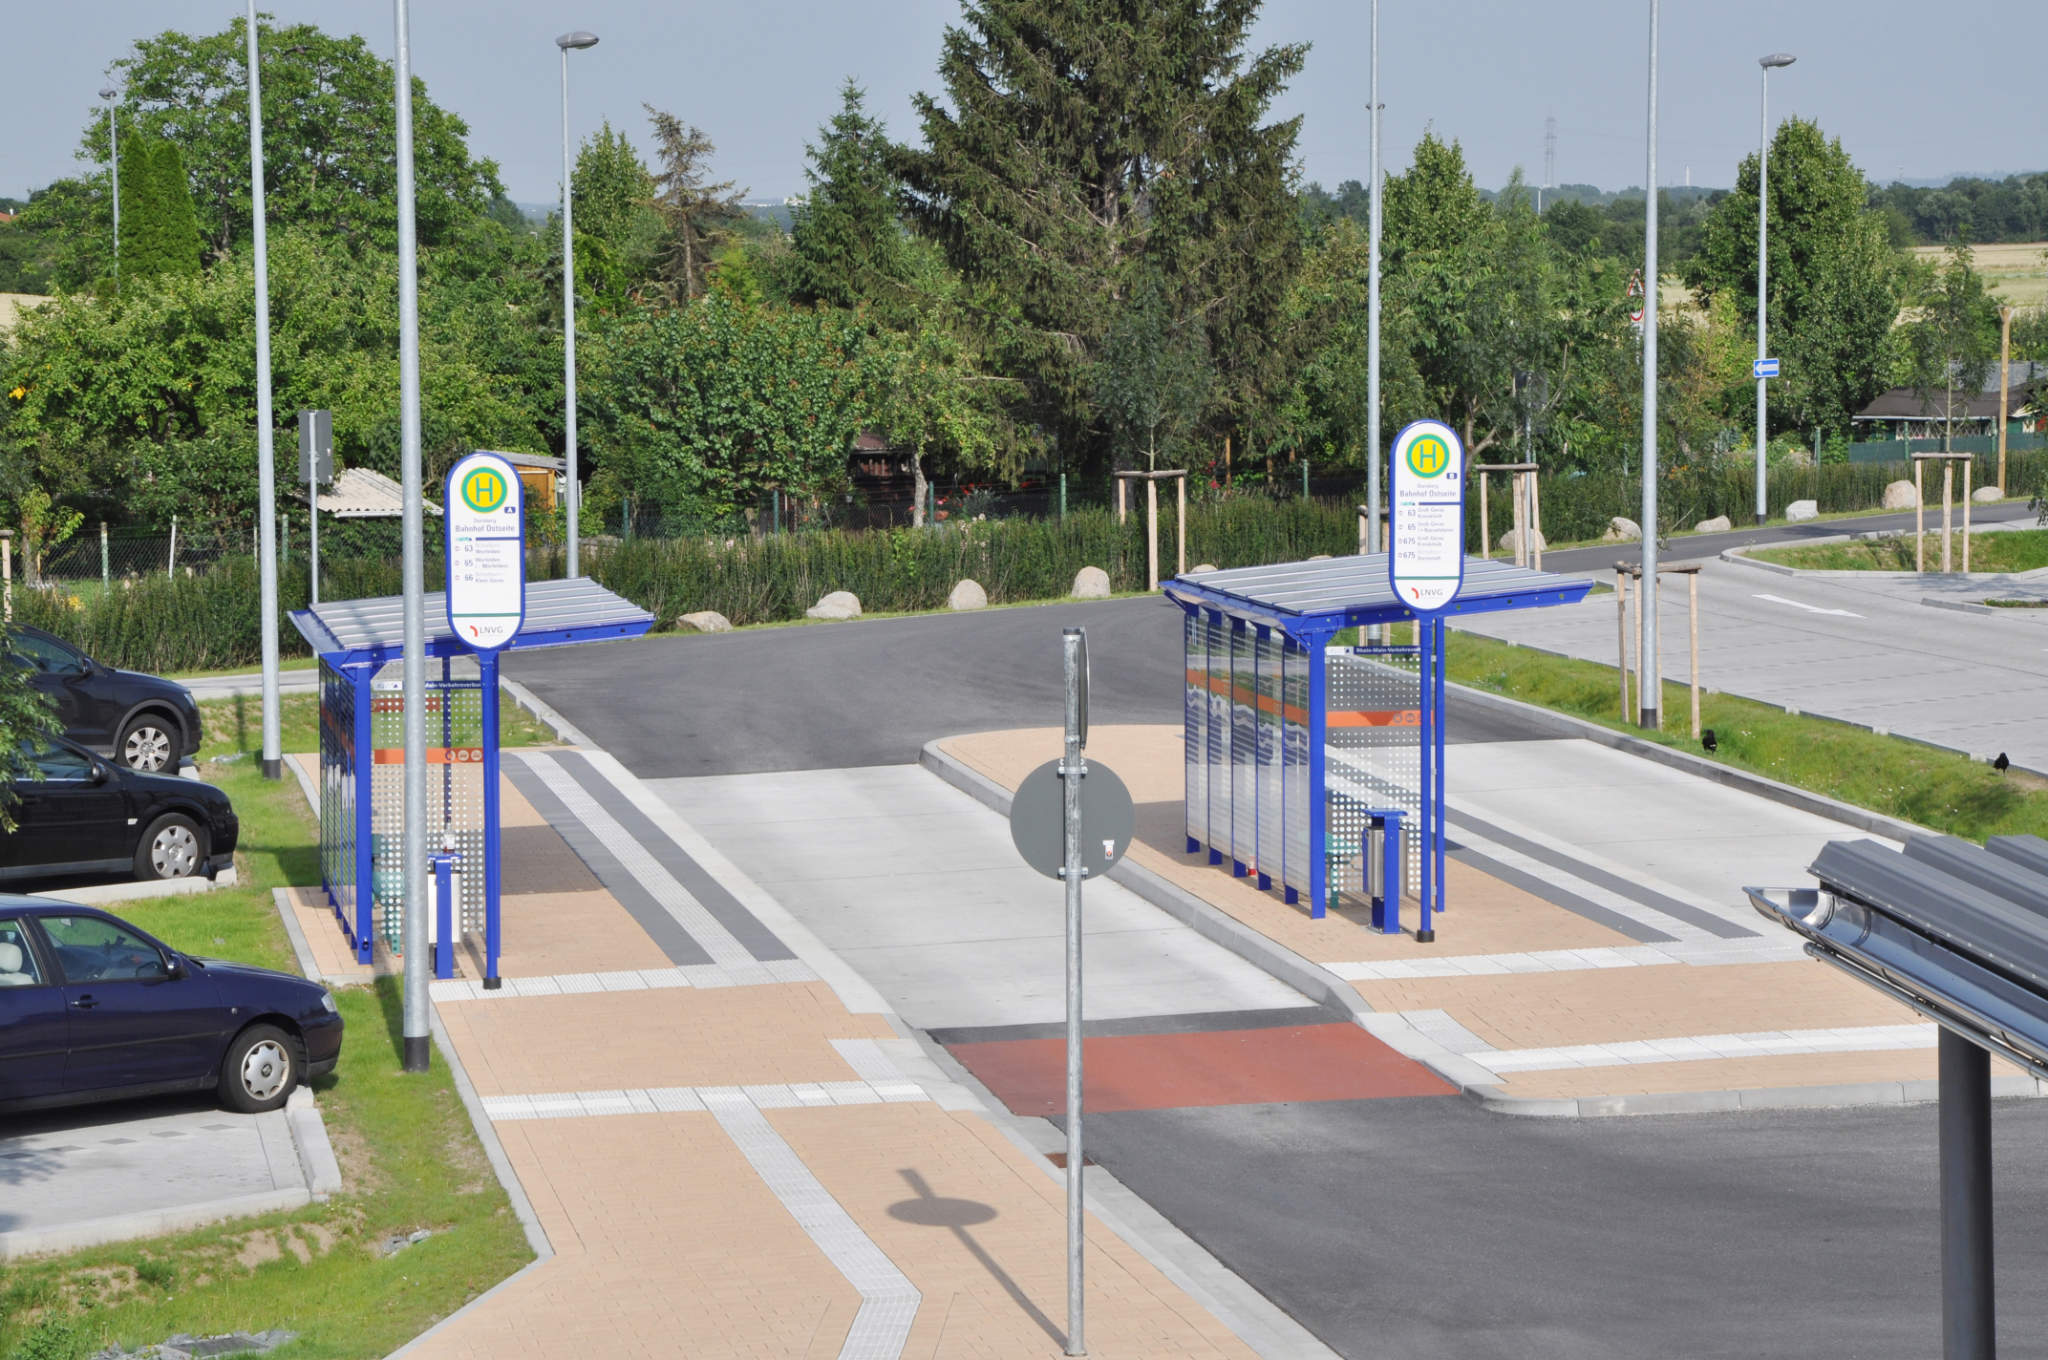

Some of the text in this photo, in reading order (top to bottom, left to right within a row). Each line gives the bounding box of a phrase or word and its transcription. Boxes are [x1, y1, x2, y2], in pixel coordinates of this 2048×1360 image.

[1420, 444, 1436, 468] H
[475, 477, 493, 502] H
[1399, 489, 1457, 498] Bahnhof Ostseite
[455, 524, 515, 533] Bahnhof Ostseite
[1403, 551, 1416, 559] 675
[480, 625, 504, 634] LNVG
